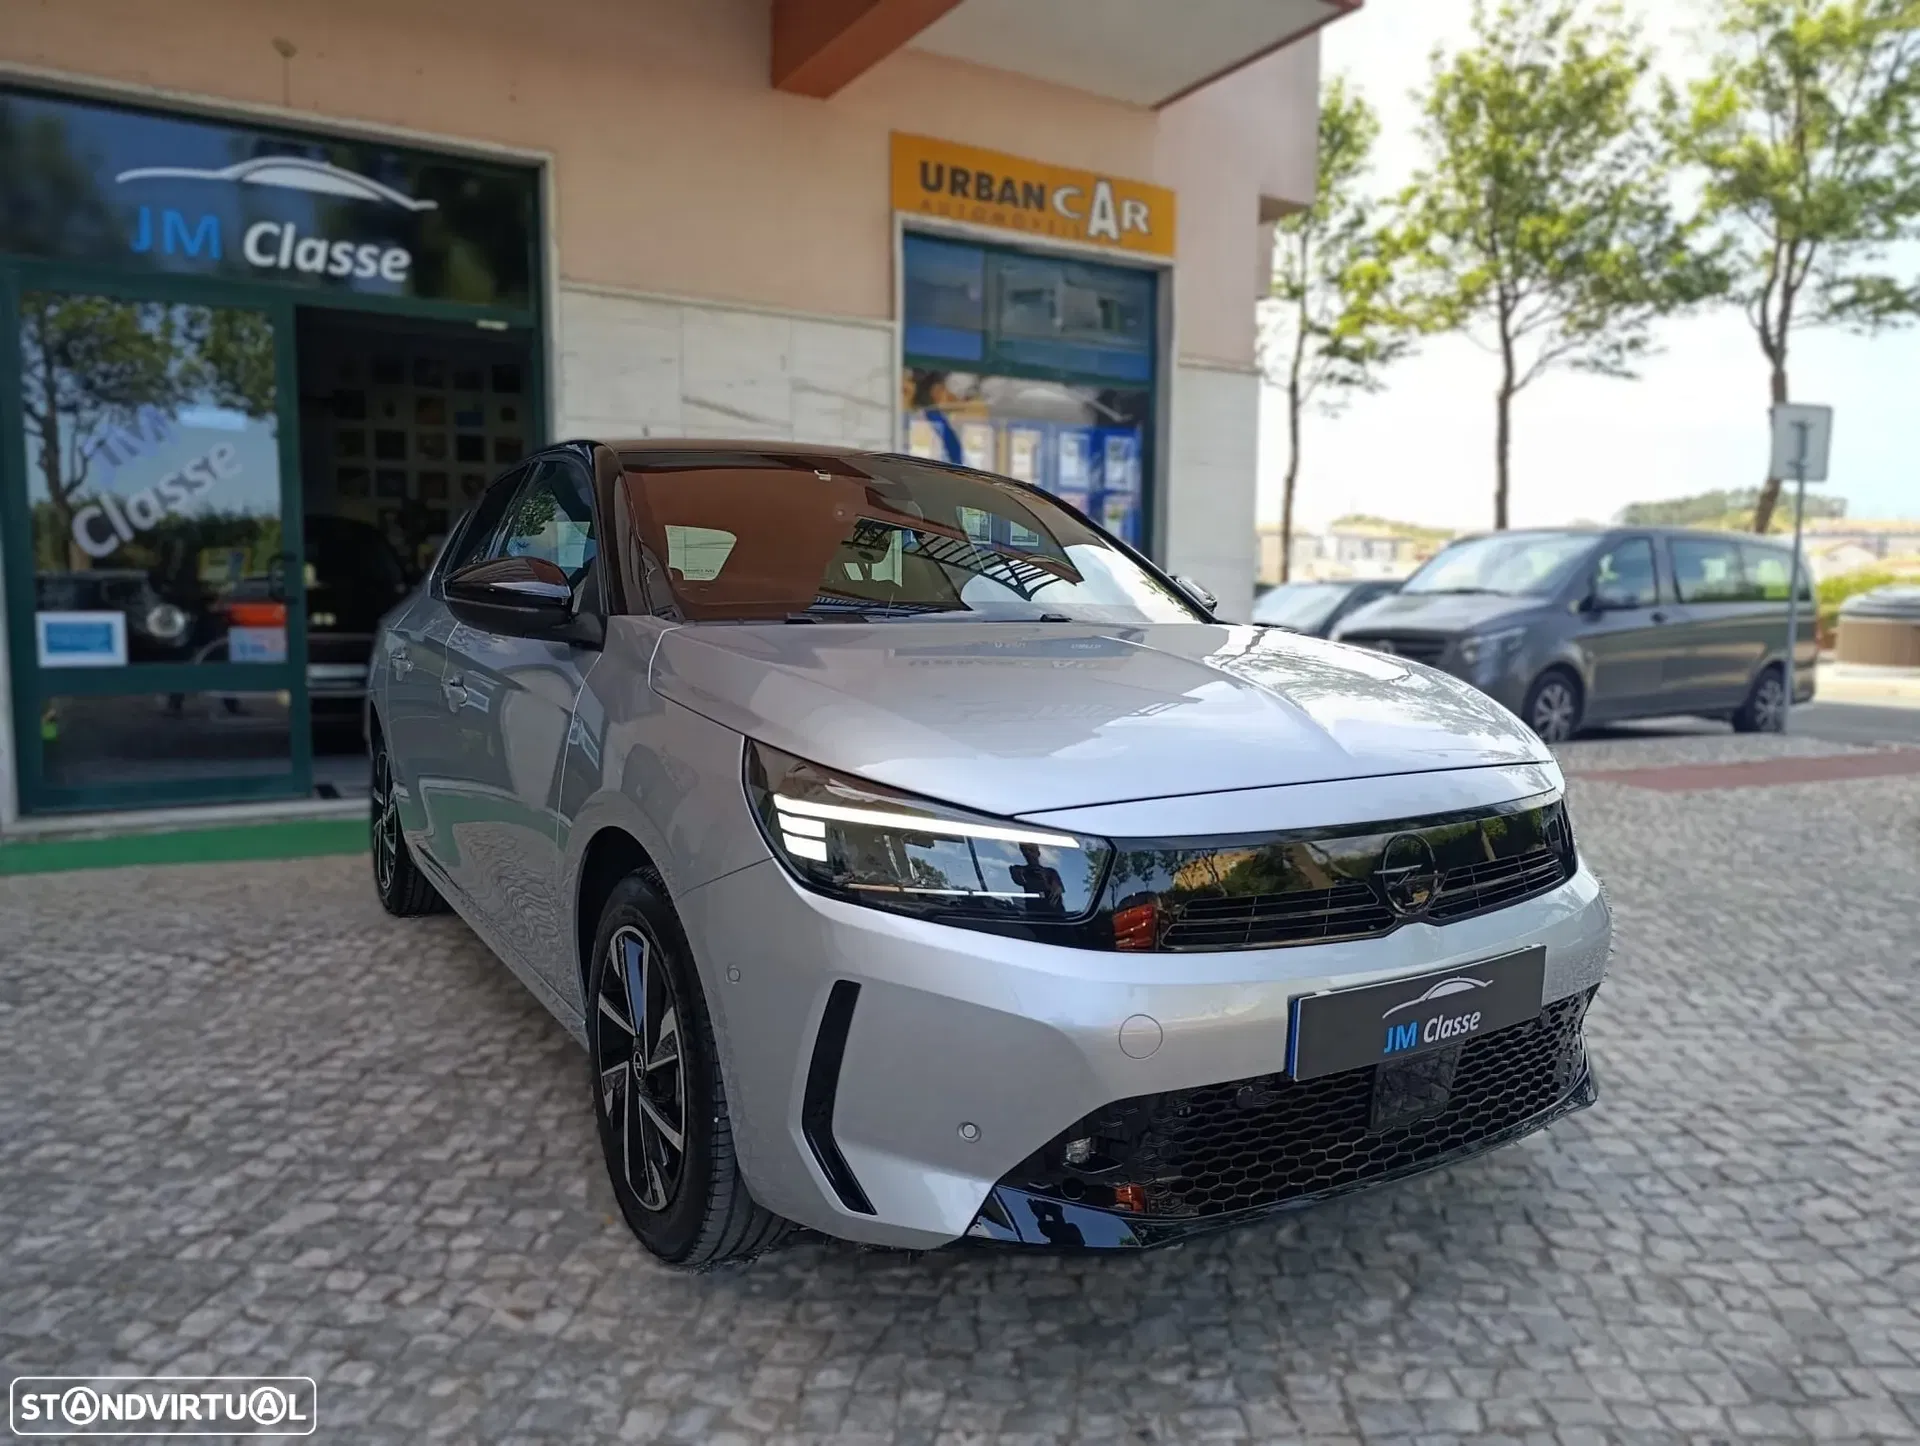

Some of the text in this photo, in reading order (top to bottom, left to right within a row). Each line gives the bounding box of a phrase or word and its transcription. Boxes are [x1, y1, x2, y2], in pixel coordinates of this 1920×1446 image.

[130, 206, 412, 282] JM Classe
[71, 441, 243, 558] Classe
[1384, 1011, 1481, 1054] JM Classe
